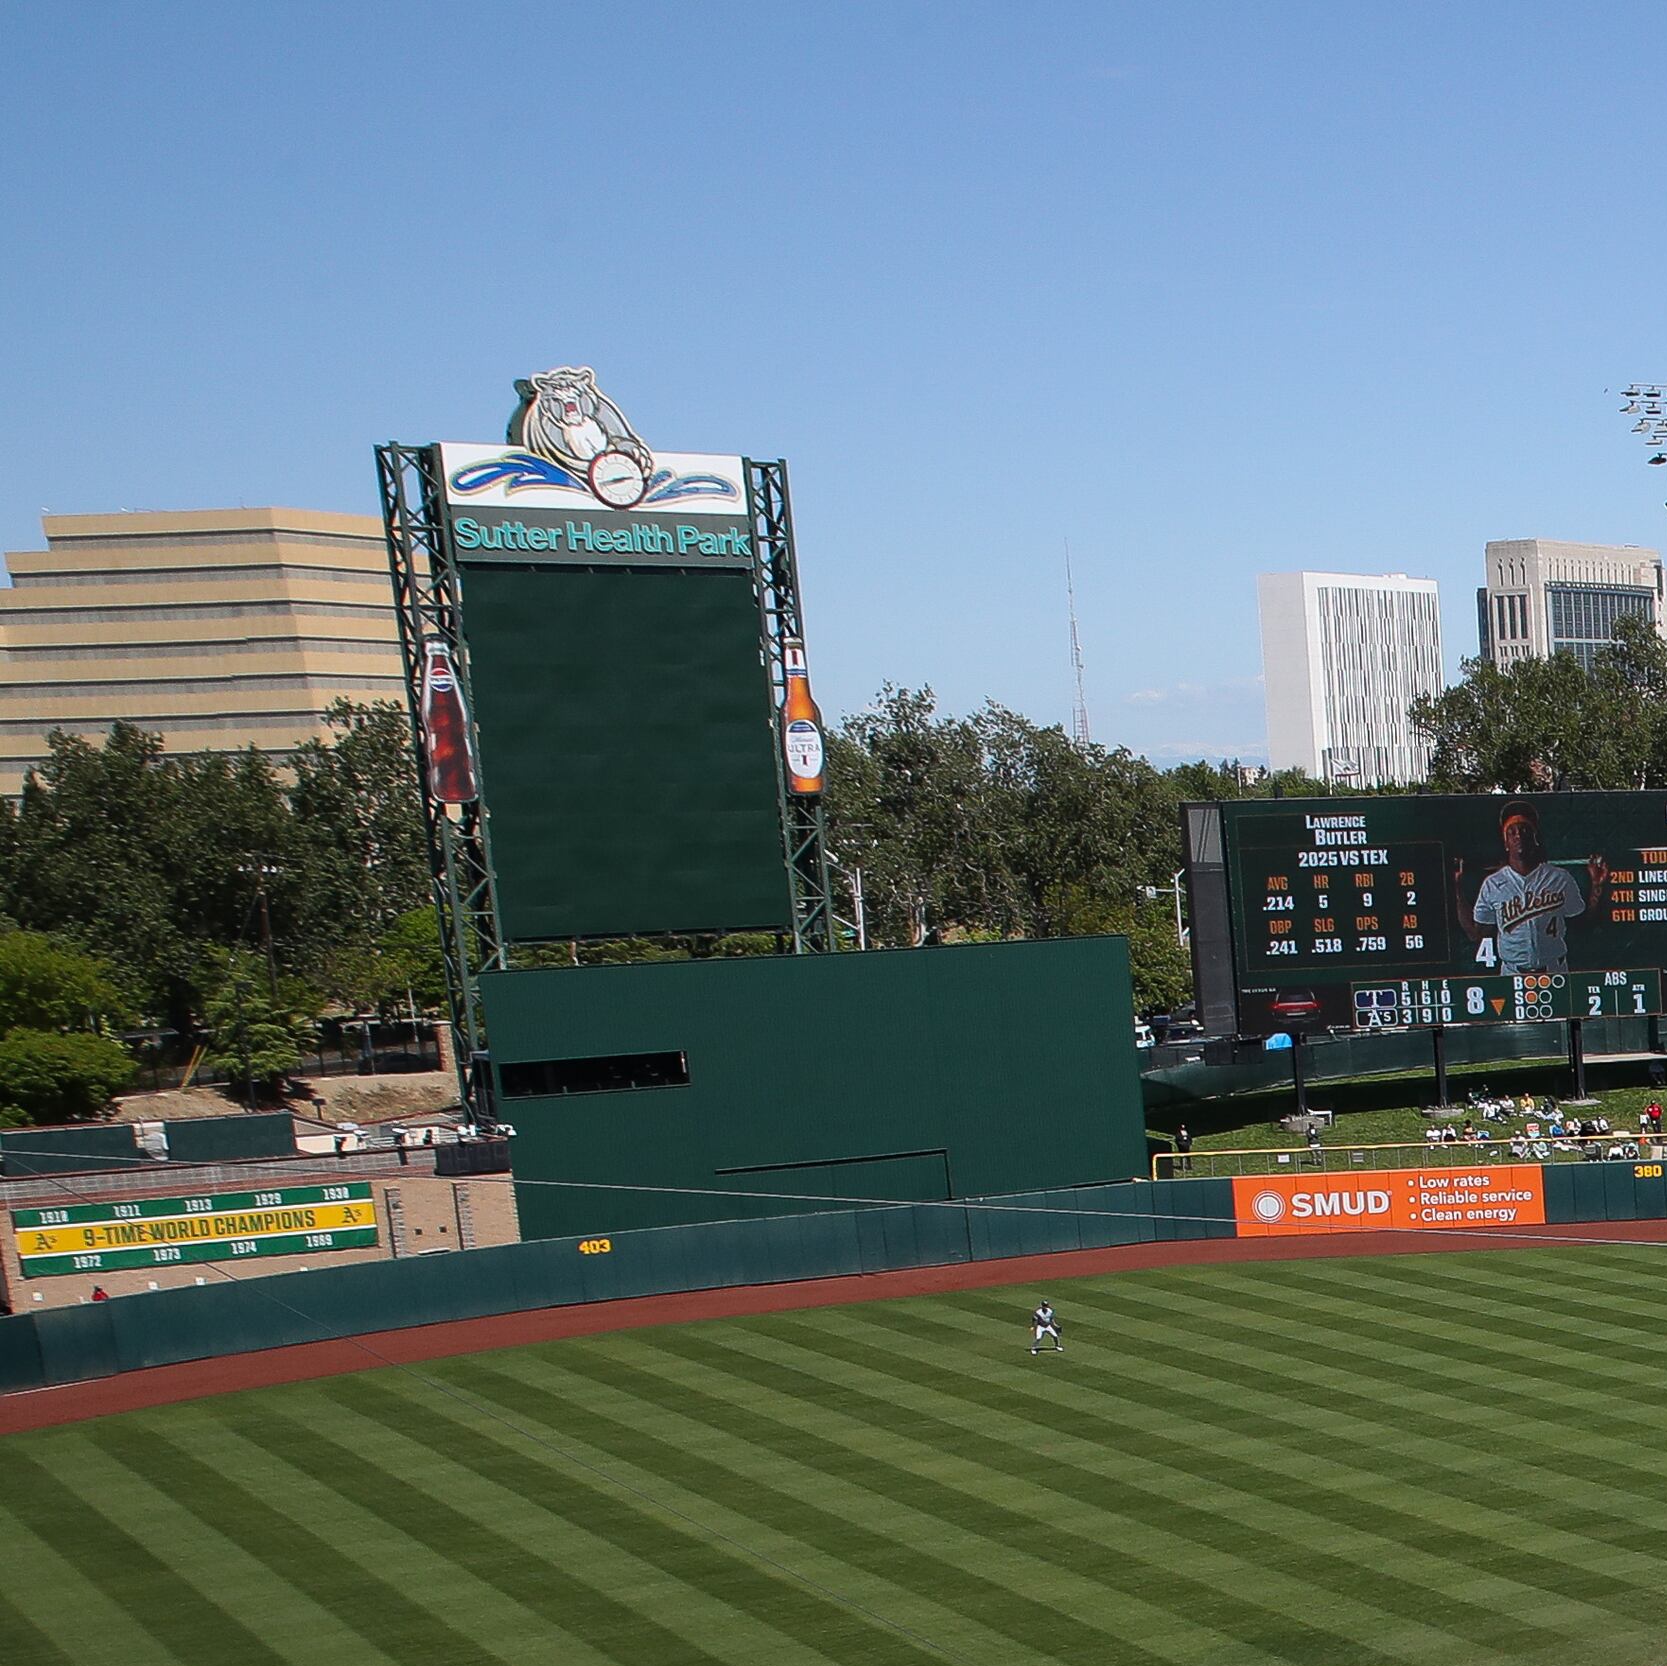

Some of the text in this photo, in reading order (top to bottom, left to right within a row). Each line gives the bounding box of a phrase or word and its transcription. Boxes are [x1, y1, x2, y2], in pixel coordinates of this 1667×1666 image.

[454, 517, 752, 557] Sutter Health Park
[1298, 850, 1388, 867] 2025 VS TEX
[1267, 872, 1414, 891] AVG HR RBI 2B
[1610, 871, 1634, 884] 2ND
[1262, 891, 1416, 911] .214 5 9 2
[1611, 890, 1634, 903] 4TH
[1501, 889, 1566, 923] Athletics
[1269, 915, 1417, 934] OBP SLG OPS AB
[1612, 910, 1635, 922] 6TH
[1546, 916, 1557, 937] 4
[1266, 935, 1424, 955] .241 .518 .759 56
[1475, 937, 1497, 968] 4
[1402, 980, 1448, 990] R H E
[1514, 976, 1523, 990] B
[1604, 972, 1627, 986] ABS
[1365, 990, 1450, 1008] T 5 6 0
[1466, 987, 1485, 1014] 8
[1515, 990, 1523, 1005] S
[1588, 993, 1646, 1016] 2 1
[1402, 1008, 1451, 1023] 3 9 0
[1516, 1005, 1525, 1019] O
[1634, 1164, 1662, 1179] 380
[1419, 1175, 1490, 1188] Low rates
[1291, 1191, 1390, 1217] SMUD
[1420, 1188, 1532, 1205] Reliable service
[113, 1205, 142, 1218] 1911
[185, 1199, 212, 1212] 1913
[254, 1193, 282, 1206] 1929
[1421, 1206, 1517, 1223] Clean energy
[83, 1223, 147, 1247] 9-TIME
[150, 1219, 211, 1240] WORLD
[215, 1209, 316, 1235] CHAMPIONS
[73, 1255, 102, 1269] 1972
[152, 1248, 181, 1262] 1973
[230, 1241, 257, 1255] 1974
[577, 1239, 612, 1255] 403
